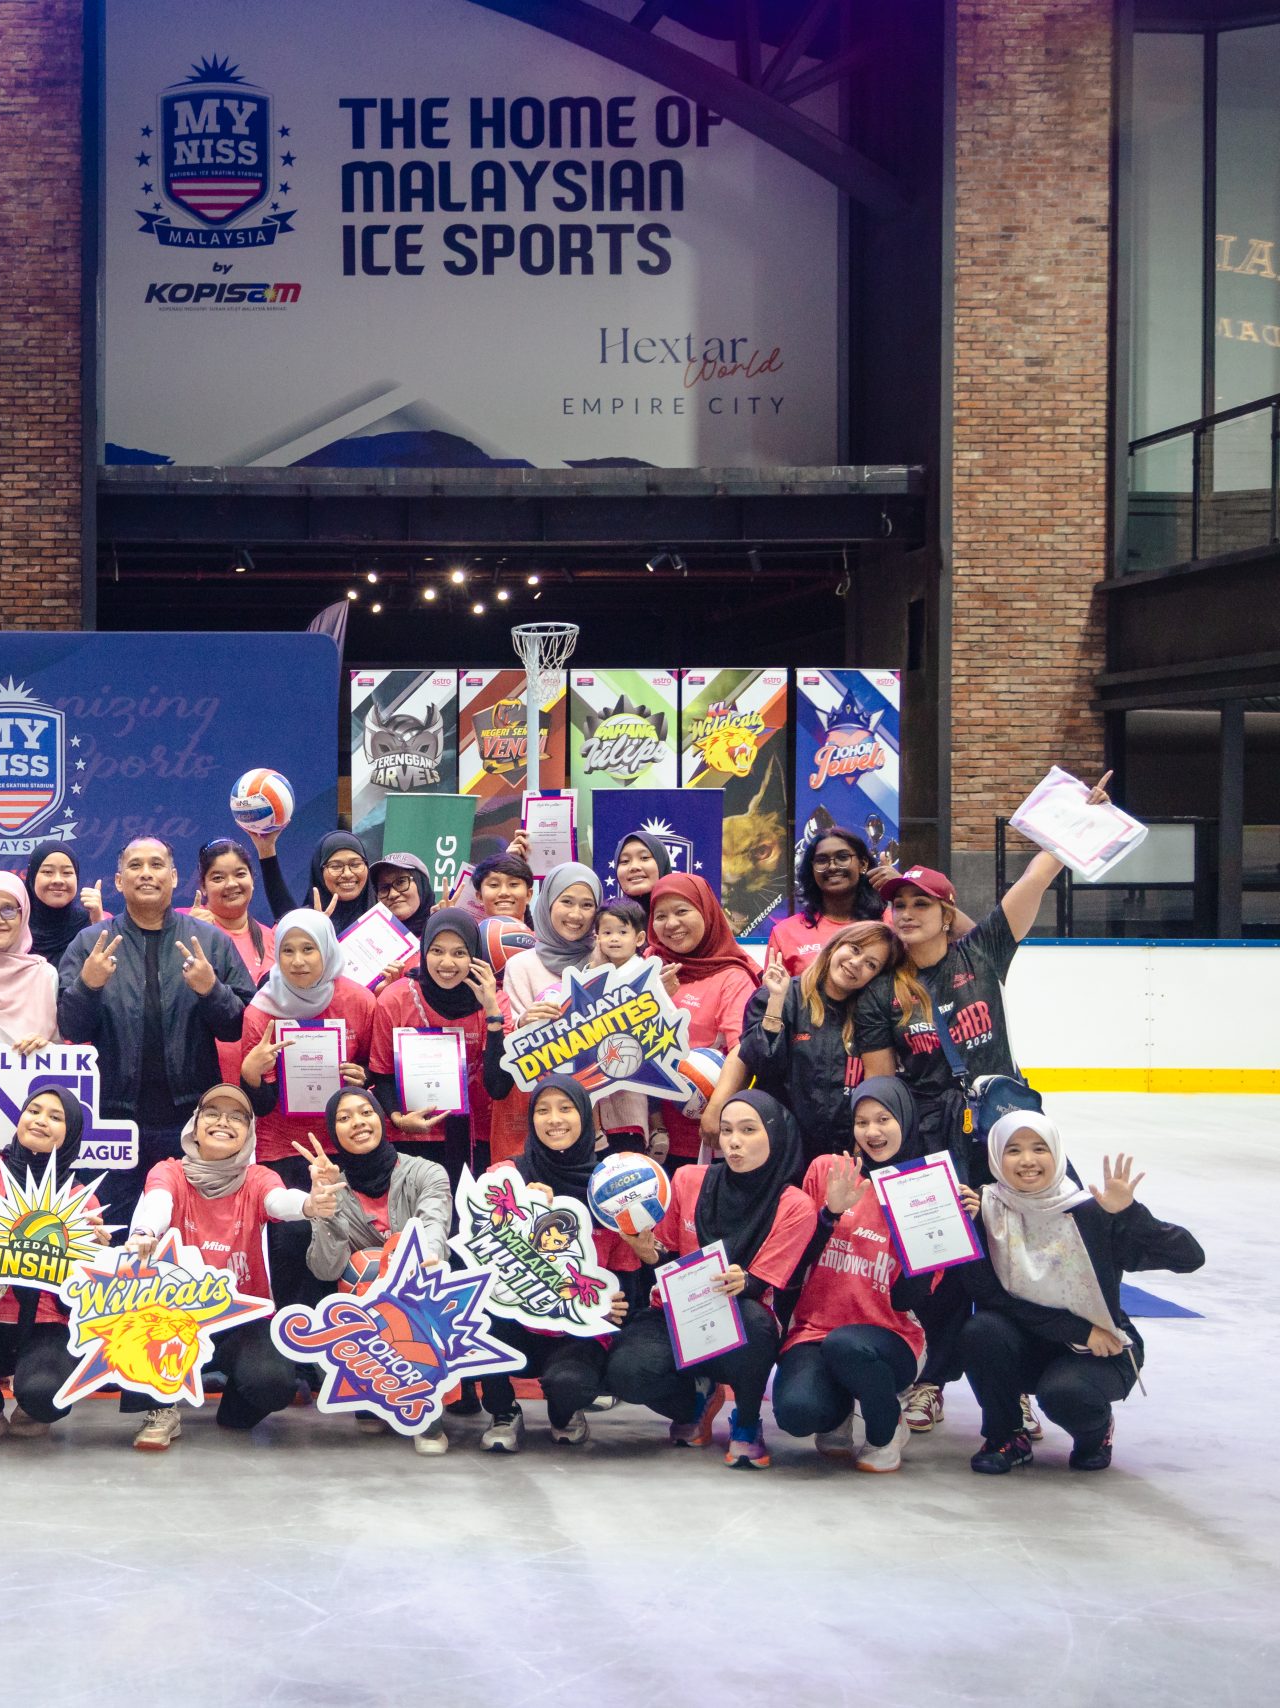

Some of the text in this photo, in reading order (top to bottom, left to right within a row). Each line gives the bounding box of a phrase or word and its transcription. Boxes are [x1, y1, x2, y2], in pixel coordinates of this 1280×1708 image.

[173, 98, 257, 136] MY
[339, 97, 451, 149] THE
[470, 96, 638, 149] HOME
[173, 139, 259, 166] NISS
[340, 159, 685, 212] MALAYSIAN
[169, 230, 267, 246] MALAYSIA
[342, 222, 672, 276] ICE SPORTS
[212, 262, 233, 275] by
[599, 327, 748, 364] Hextar
[563, 397, 784, 415] EMPIRE CITY
[481, 728, 511, 738] NEGERI
[597, 723, 659, 741] PAHANG
[689, 709, 765, 742] Wildcats
[582, 734, 666, 774] Tulips
[809, 742, 887, 790] Jewels
[434, 835, 457, 891] ESG
[513, 985, 637, 1056] PUTRAJAYA
[516, 991, 660, 1083] DYNAMITES
[966, 1032, 993, 1050] 2026
[13, 1239, 61, 1255] KEDAH
[201, 1240, 231, 1252] Mitre
[502, 1226, 562, 1289] MELAKA
[829, 1238, 854, 1252] NSL
[115, 1253, 159, 1280] KL
[470, 1233, 558, 1315] MYSTIC
[68, 1271, 231, 1319] Wildcats
[282, 1303, 434, 1422] Jewels
[358, 1333, 424, 1387] JOHOR
